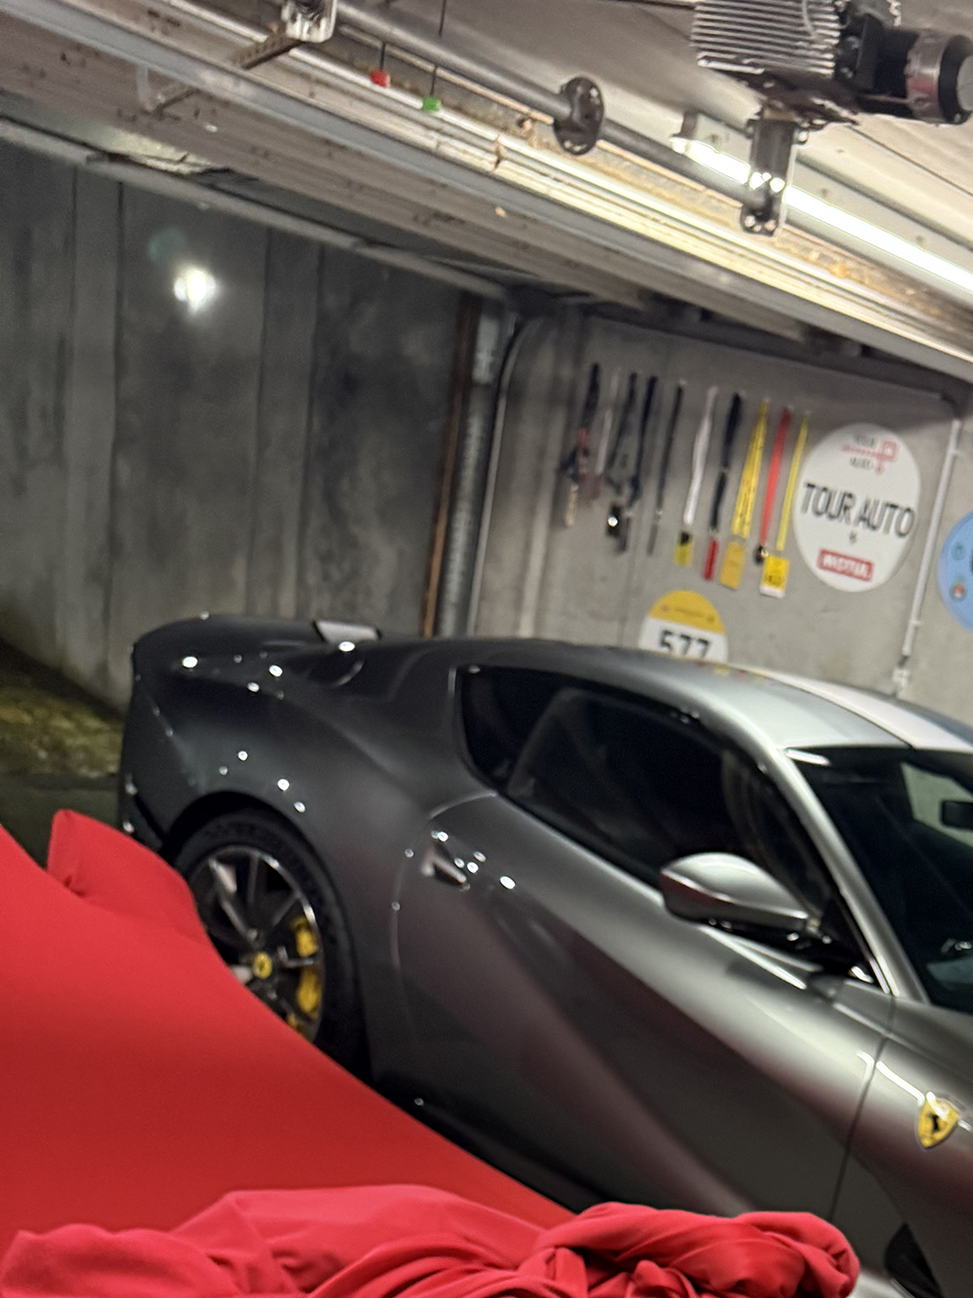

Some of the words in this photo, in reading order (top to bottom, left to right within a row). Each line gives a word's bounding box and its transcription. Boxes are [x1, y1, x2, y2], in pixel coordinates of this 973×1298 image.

[802, 482, 854, 526] TOUR
[855, 498, 915, 538] AUTO
[659, 629, 711, 658] 577
